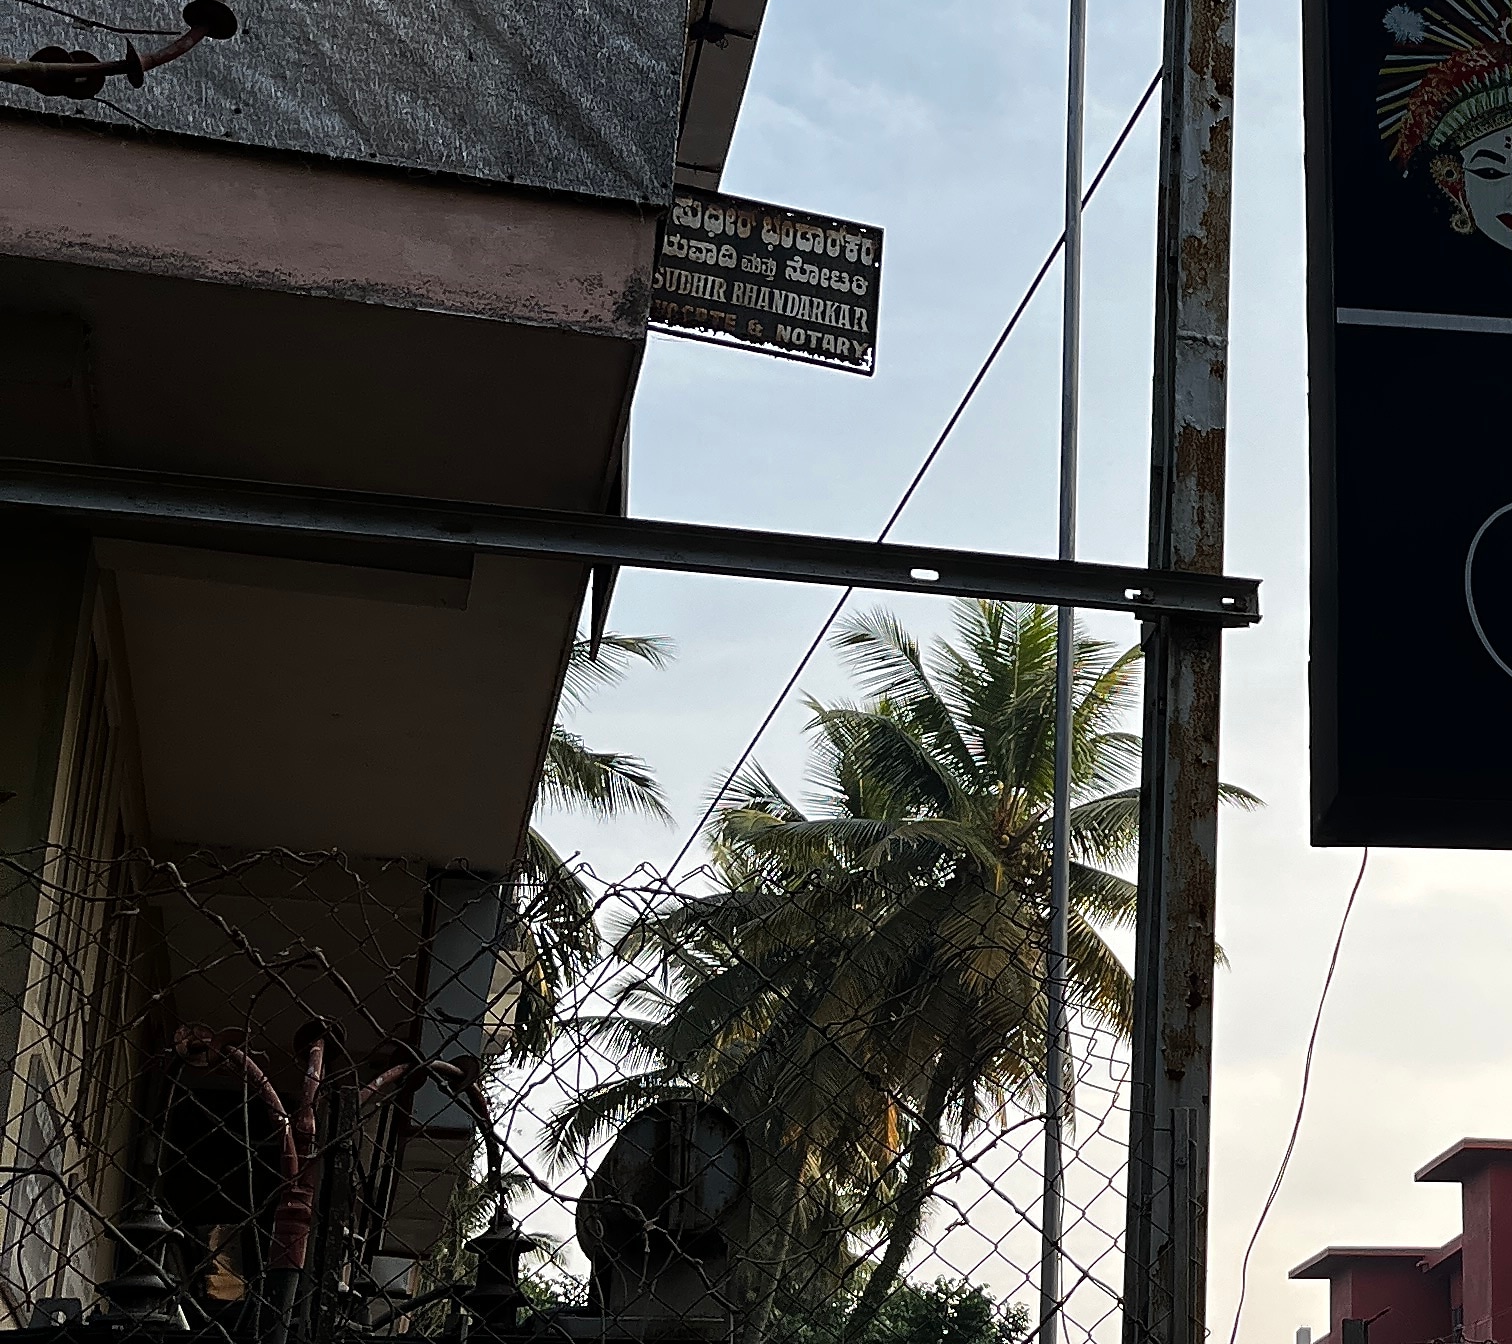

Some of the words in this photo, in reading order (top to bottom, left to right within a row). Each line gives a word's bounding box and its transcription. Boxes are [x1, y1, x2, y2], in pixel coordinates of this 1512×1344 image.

[652, 267, 727, 303] SUDHIR
[732, 281, 869, 333] BHANDARKAR
[775, 324, 870, 358] NOTARY
